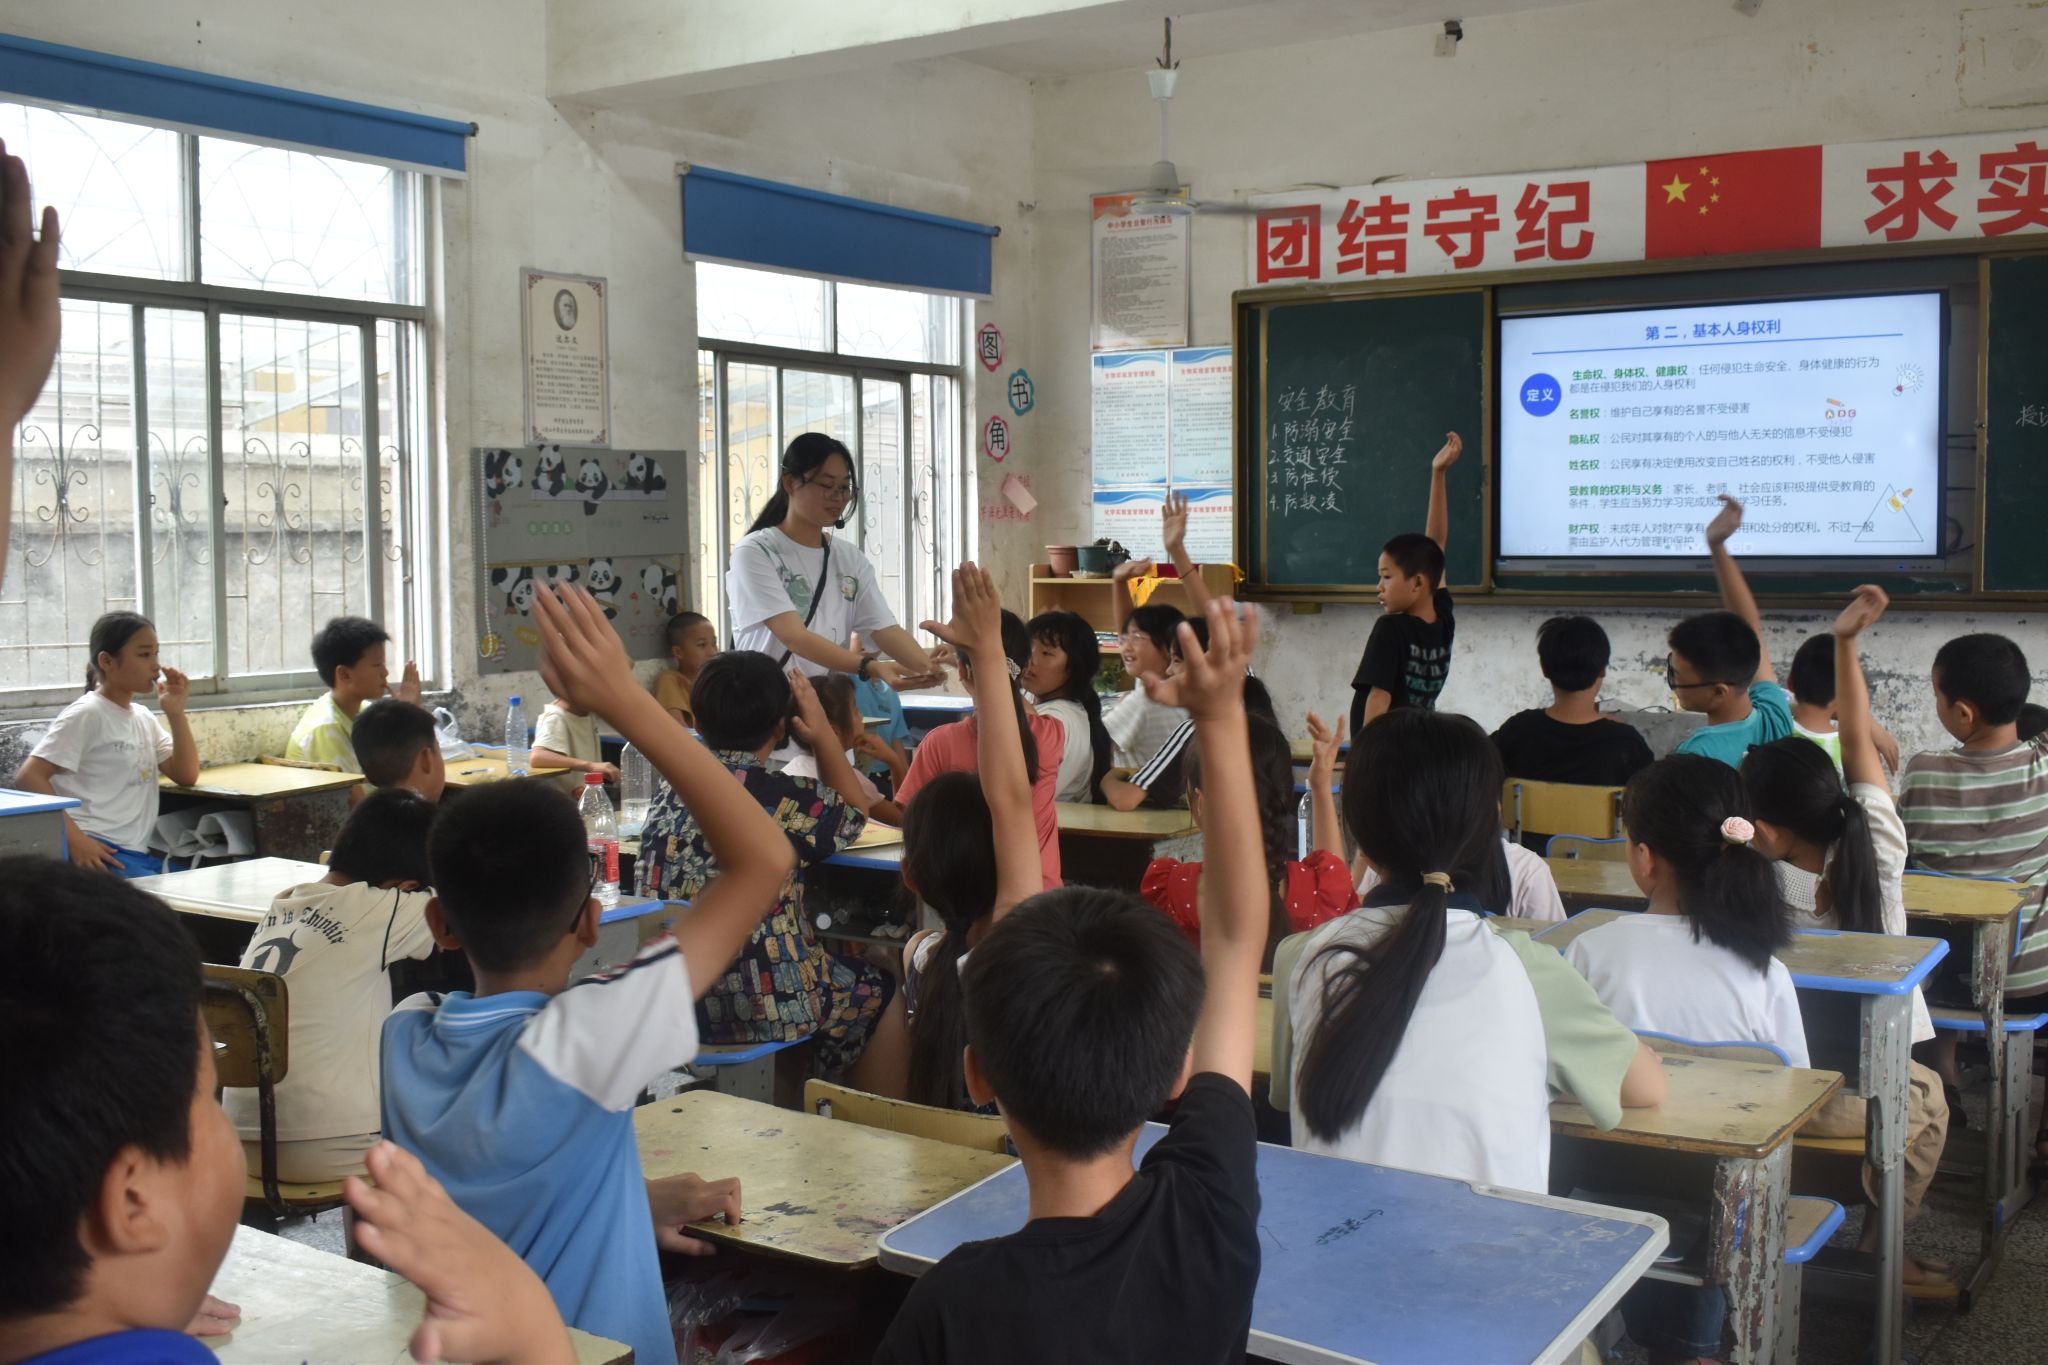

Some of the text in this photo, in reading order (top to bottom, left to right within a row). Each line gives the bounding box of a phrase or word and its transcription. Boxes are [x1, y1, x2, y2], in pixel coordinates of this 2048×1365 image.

[1256, 181, 1595, 284] 团结守纪
[1864, 140, 2048, 242] 求实
[1526, 387, 1554, 403] 定义
